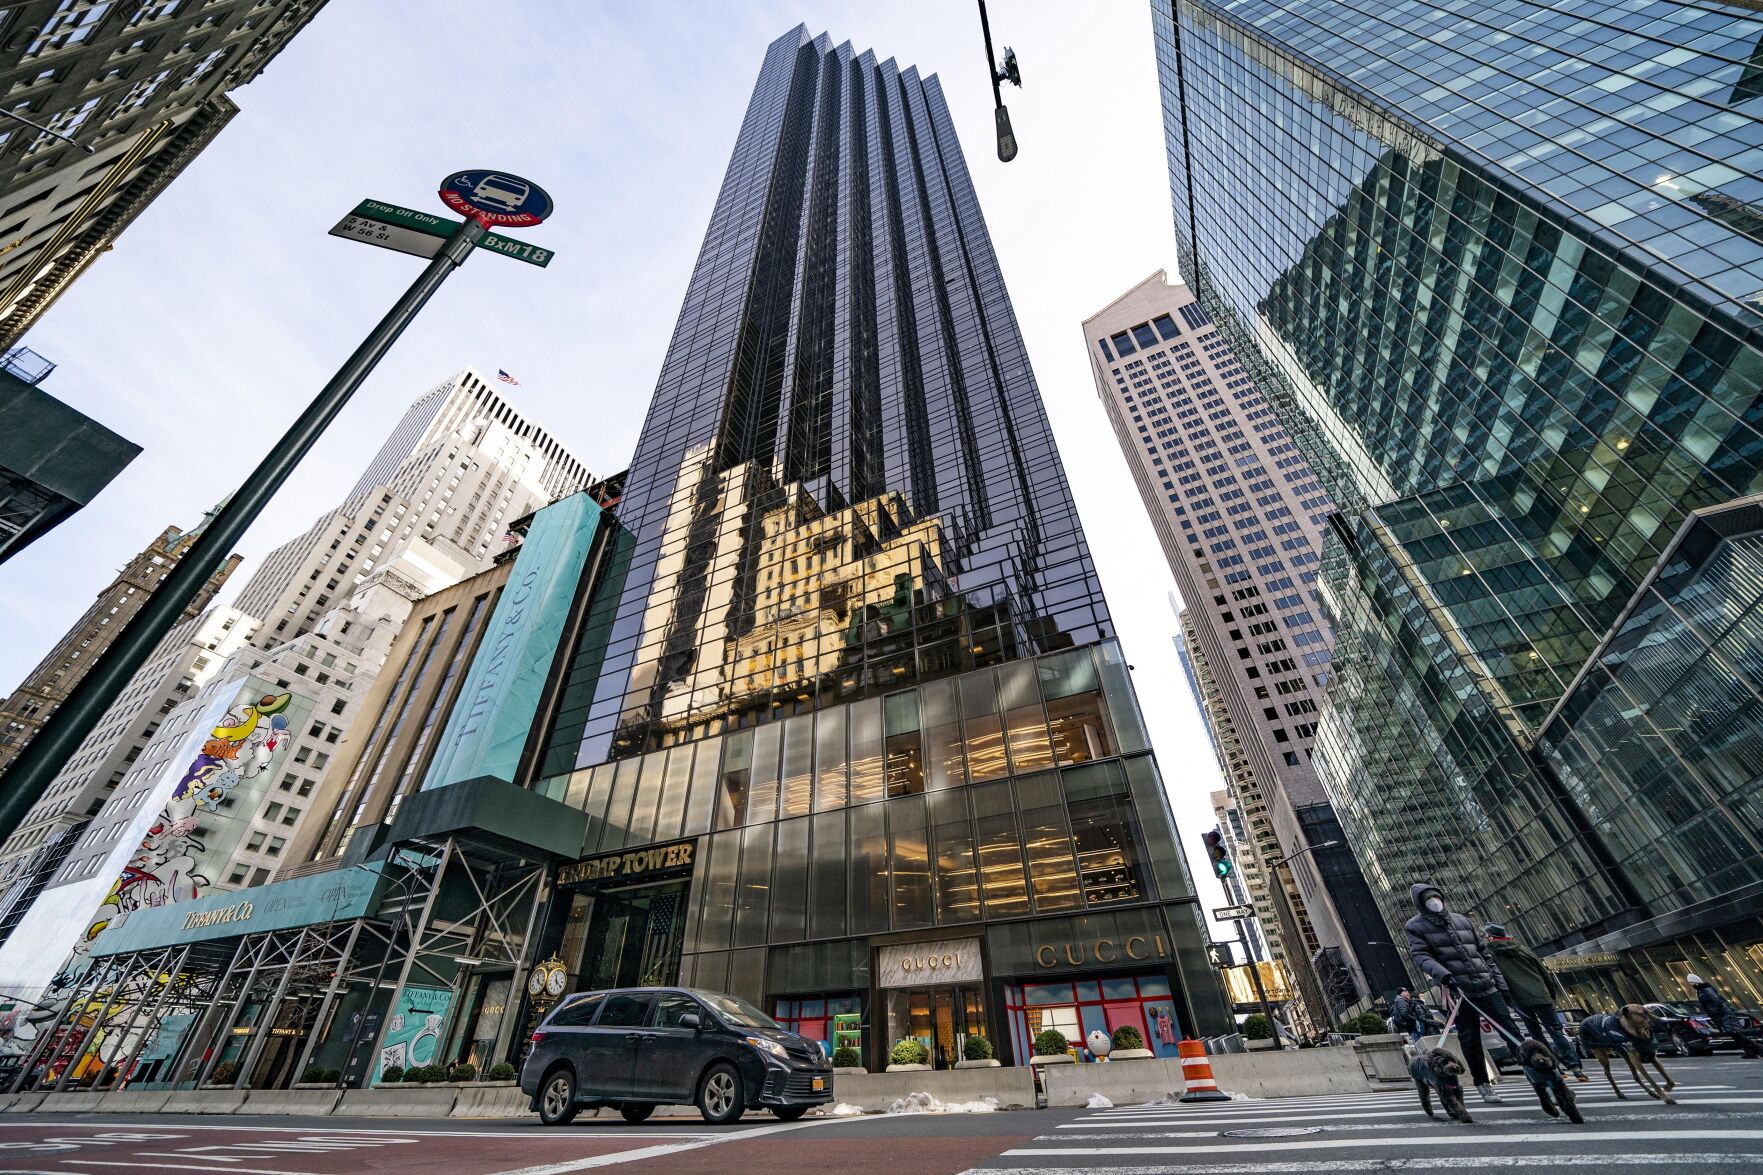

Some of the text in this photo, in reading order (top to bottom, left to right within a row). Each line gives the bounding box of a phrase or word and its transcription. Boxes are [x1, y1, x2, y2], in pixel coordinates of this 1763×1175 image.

[367, 201, 440, 225] Drop Off Only
[445, 193, 532, 223] NO STANDING
[342, 224, 390, 241] W 56 St
[359, 220, 376, 228] Av
[484, 235, 548, 262] BxM18
[557, 843, 694, 885] TRUMP TOWER
[1236, 907, 1248, 915] WAY
[901, 952, 961, 971] GUCCI
[1036, 935, 1166, 969] GUCCI
[484, 1005, 504, 1015] GUCC
